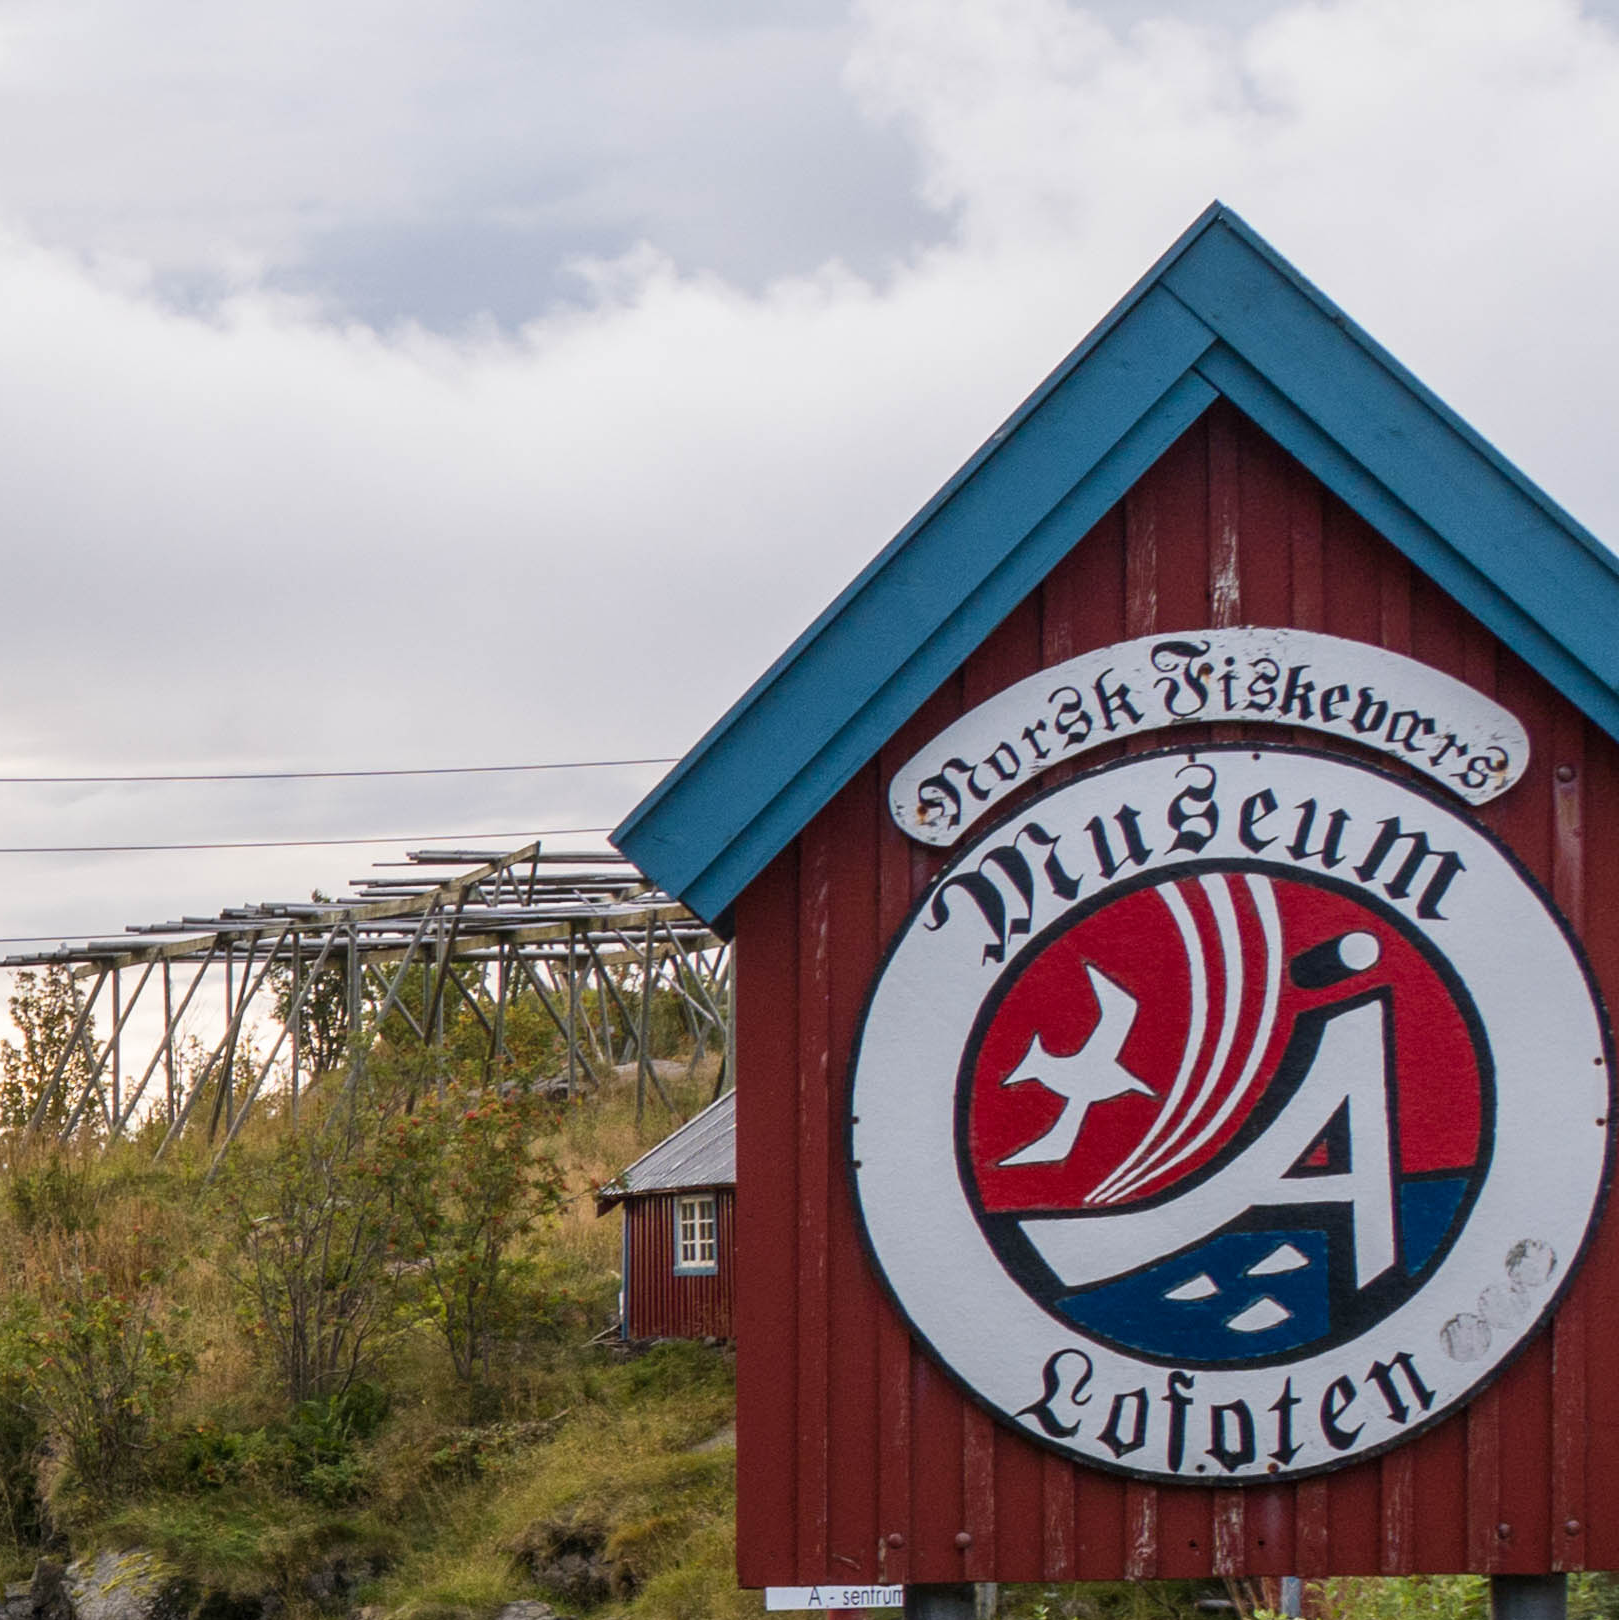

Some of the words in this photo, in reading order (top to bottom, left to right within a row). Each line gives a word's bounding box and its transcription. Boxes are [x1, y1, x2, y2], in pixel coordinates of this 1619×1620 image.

[916, 678, 1146, 830] Norsk
[1151, 640, 1513, 790] Fiskeværs
[923, 763, 1469, 967] Museum
[1015, 1348, 1438, 1474] Lofoten
